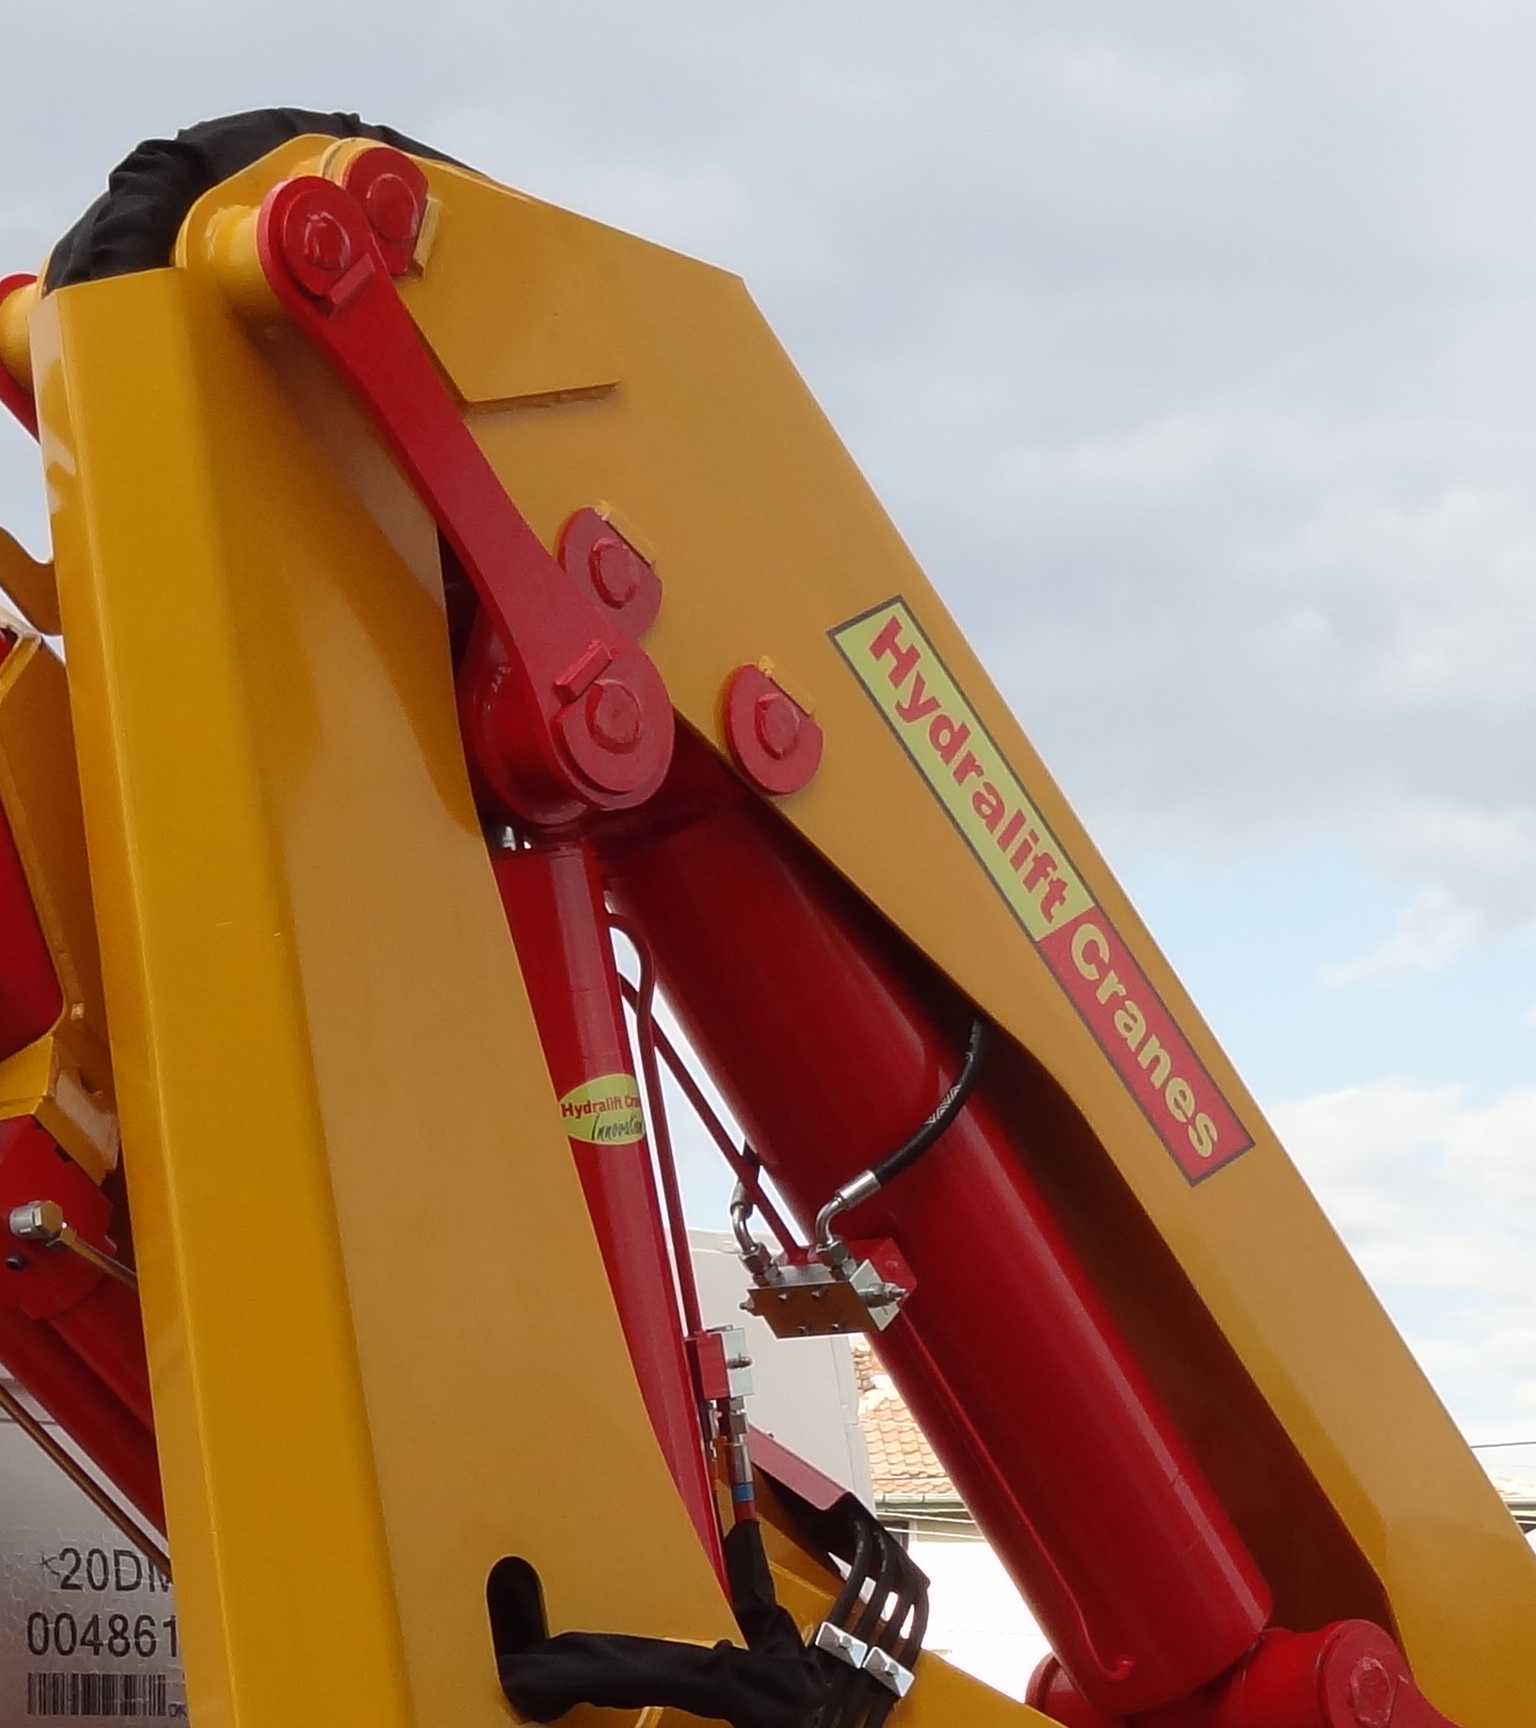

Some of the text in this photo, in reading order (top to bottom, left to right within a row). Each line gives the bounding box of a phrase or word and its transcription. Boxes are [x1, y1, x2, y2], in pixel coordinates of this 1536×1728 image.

[868, 614, 1220, 1160] Hydralift Cranes
[560, 1096, 623, 1119] Hydralift
[26, 1611, 178, 1658] 004861
